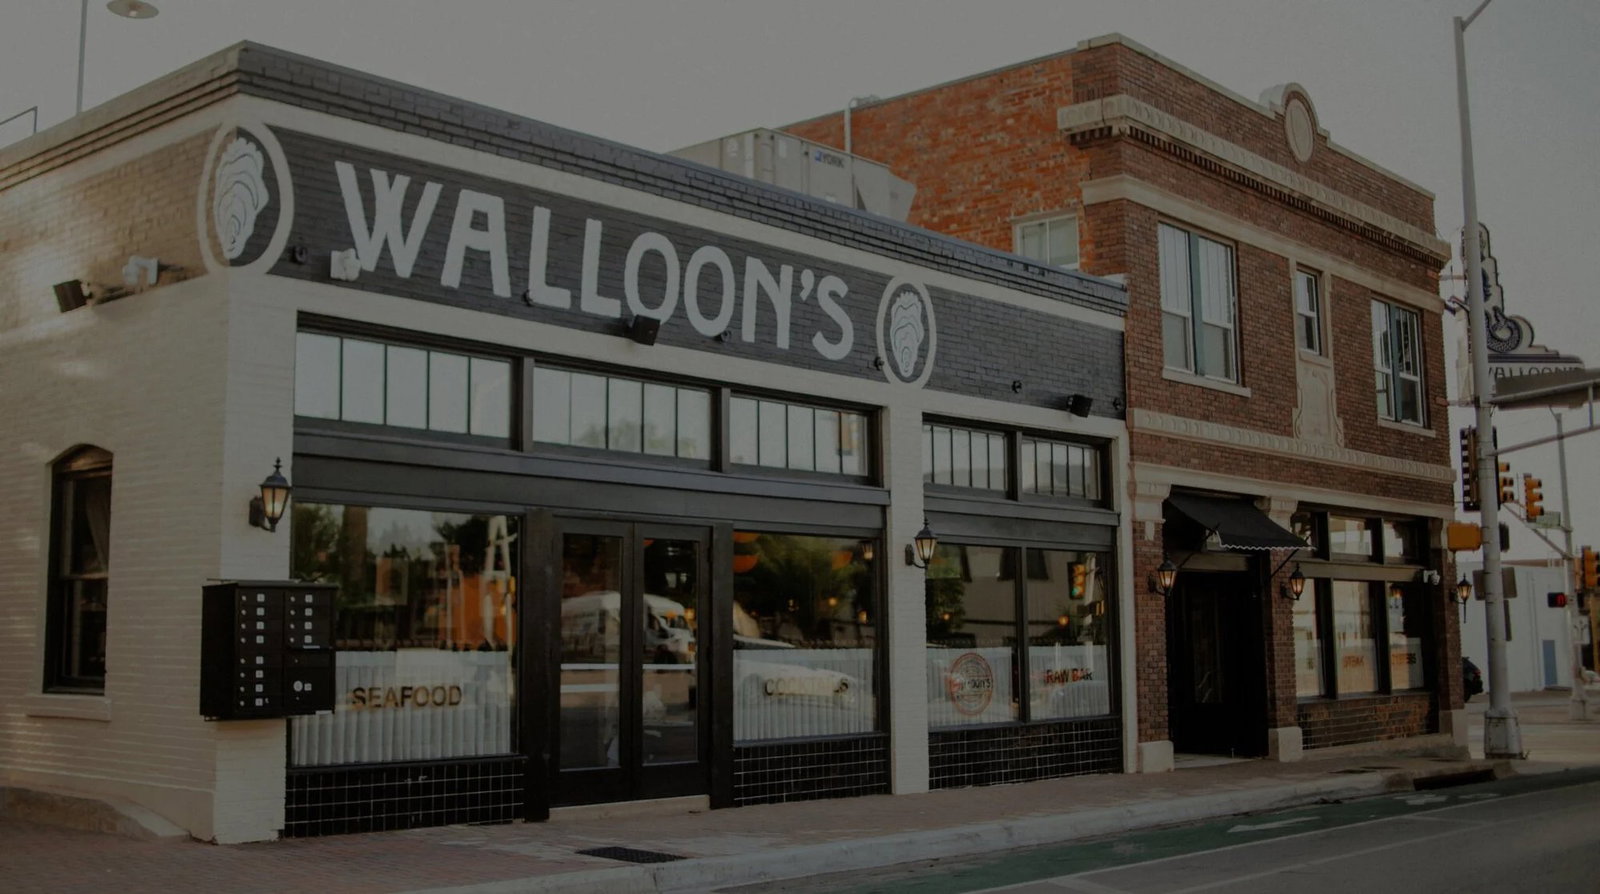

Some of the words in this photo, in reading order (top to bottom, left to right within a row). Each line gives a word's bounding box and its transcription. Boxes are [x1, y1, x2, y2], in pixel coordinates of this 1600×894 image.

[334, 160, 854, 361] WALLOON'S
[1488, 366, 1582, 380] ALLOON
[352, 685, 462, 708] SEAFOOD
